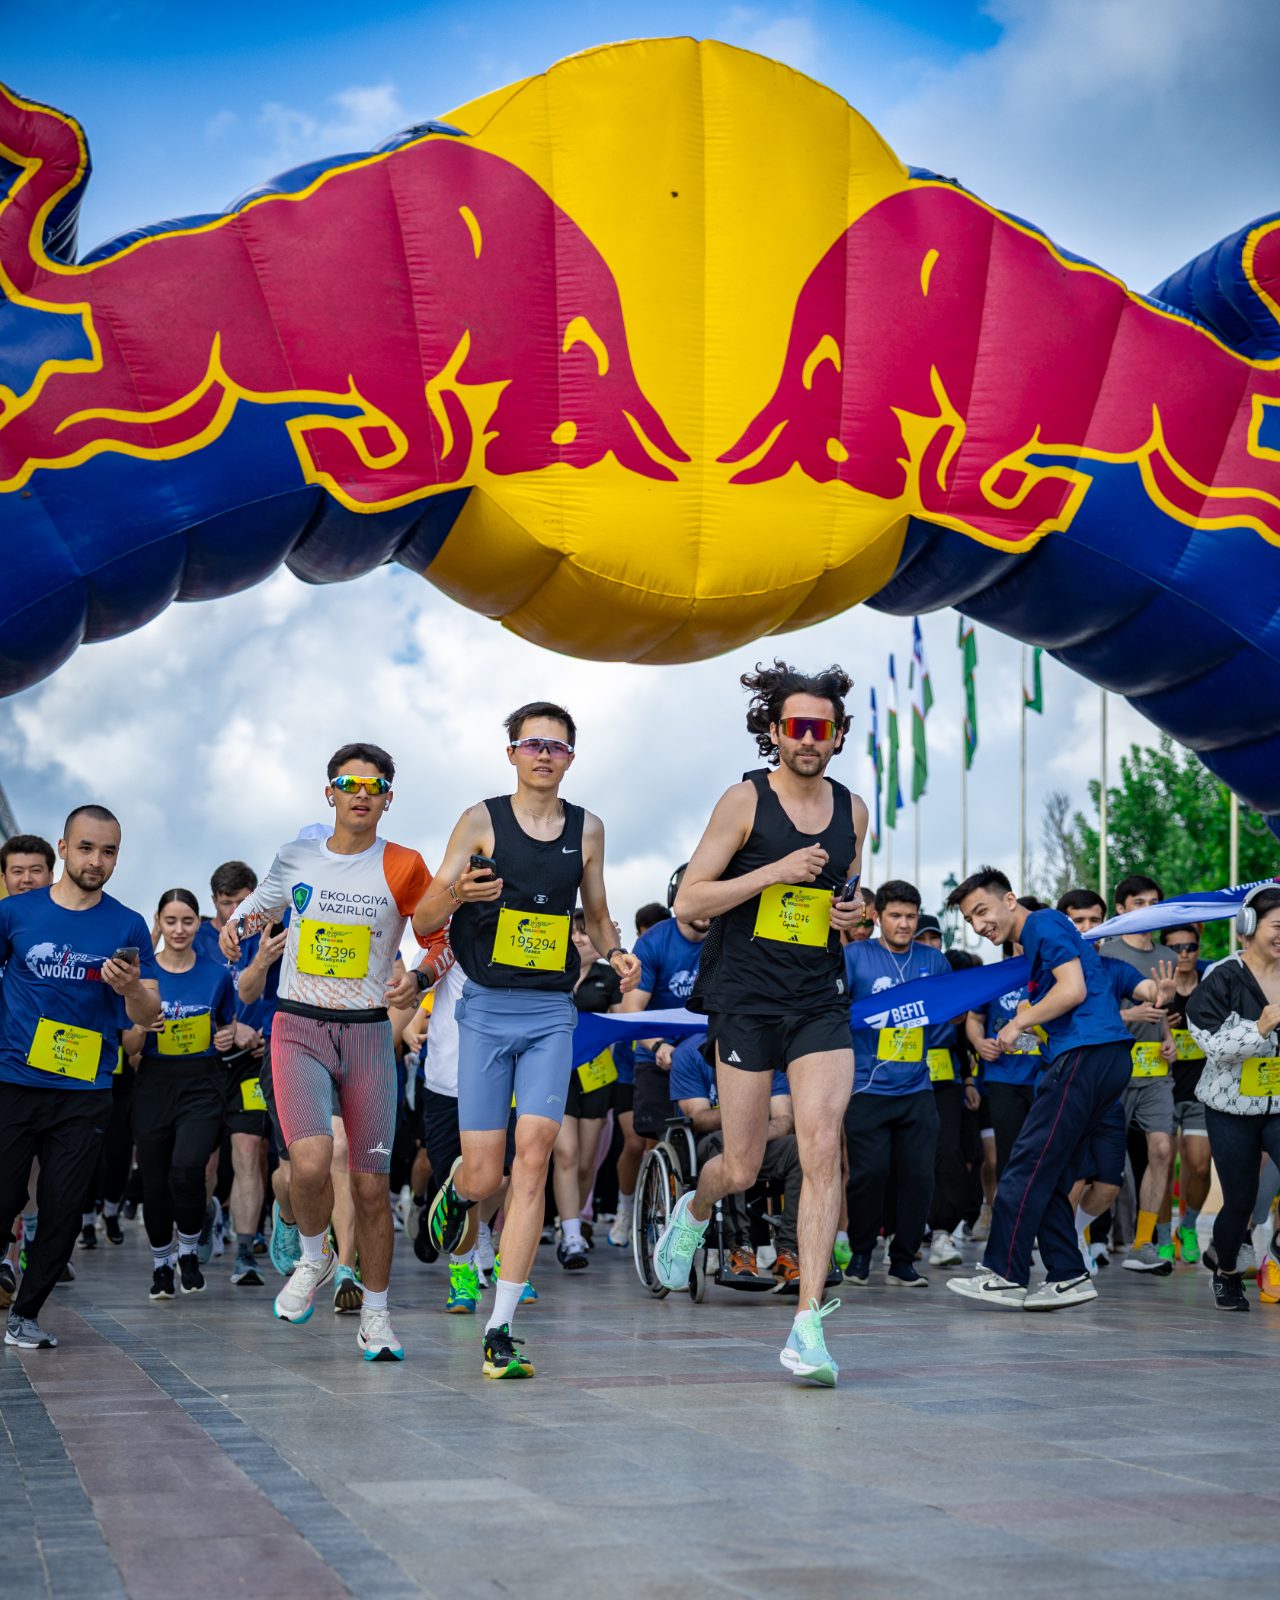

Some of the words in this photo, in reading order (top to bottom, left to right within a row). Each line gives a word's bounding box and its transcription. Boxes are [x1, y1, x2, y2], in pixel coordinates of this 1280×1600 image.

[320, 890, 388, 907] EKOLOGIYA
[318, 902, 377, 918] VAZIRLIGI
[310, 943, 356, 959] 197396
[510, 935, 556, 951] 195294
[54, 951, 88, 961] WINGS
[40, 963, 86, 980] WORLD
[86, 968, 102, 981] RU
[890, 1000, 926, 1023] BEFIT
